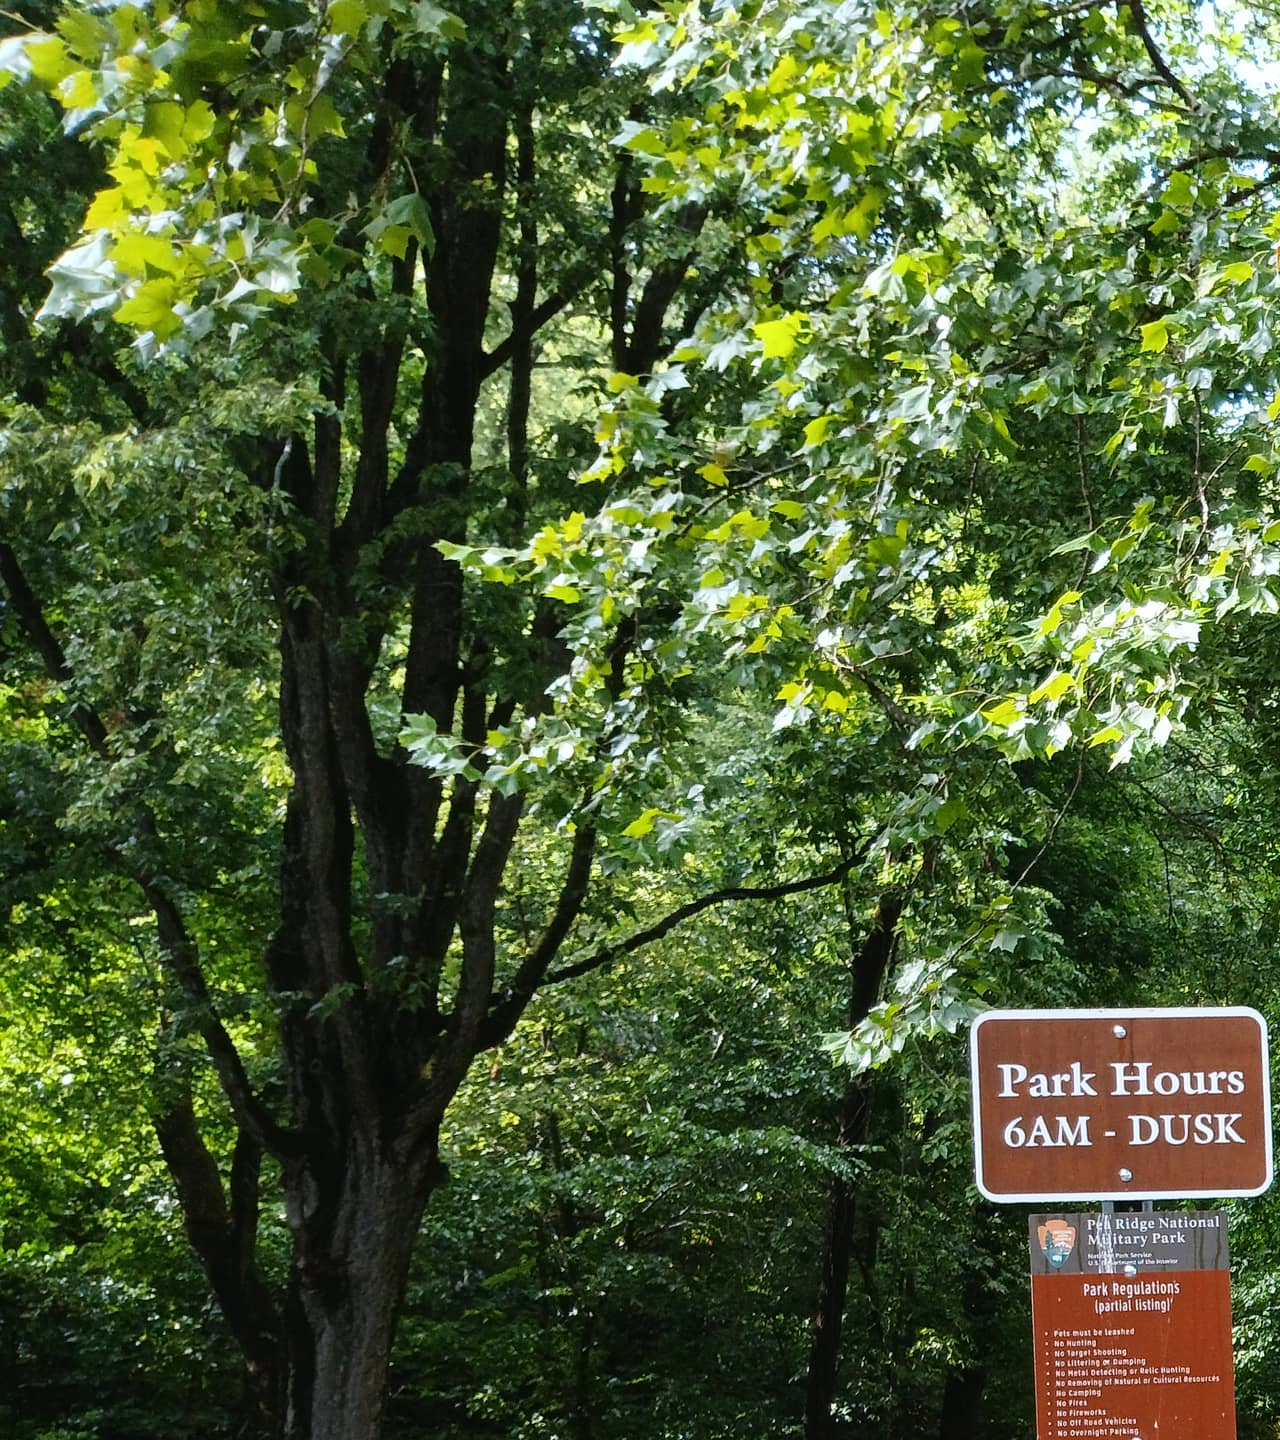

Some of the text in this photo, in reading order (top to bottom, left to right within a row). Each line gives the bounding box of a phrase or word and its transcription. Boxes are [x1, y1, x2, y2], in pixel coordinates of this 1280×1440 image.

[997, 1062, 1245, 1098] Park Hours
[1003, 1113, 1246, 1148] 6AM - DUSK
[1116, 1217, 1155, 1231] Ridge
[1159, 1216, 1220, 1229] National
[1152, 1232, 1185, 1245] Park
[1083, 1280, 1180, 1298] Park Regulations
[1095, 1299, 1171, 1315] (partial listing)
[1105, 1328, 1135, 1336] leashed
[1067, 1349, 1091, 1357] Target
[1113, 1358, 1146, 1366] Dumping
[1091, 1368, 1127, 1376] Detecting
[1161, 1366, 1191, 1374] Hunting
[1068, 1379, 1102, 1387] Removing
[1068, 1389, 1101, 1397] Camping
[1070, 1428, 1108, 1436] Overnight
[1110, 1427, 1139, 1435] Parking
